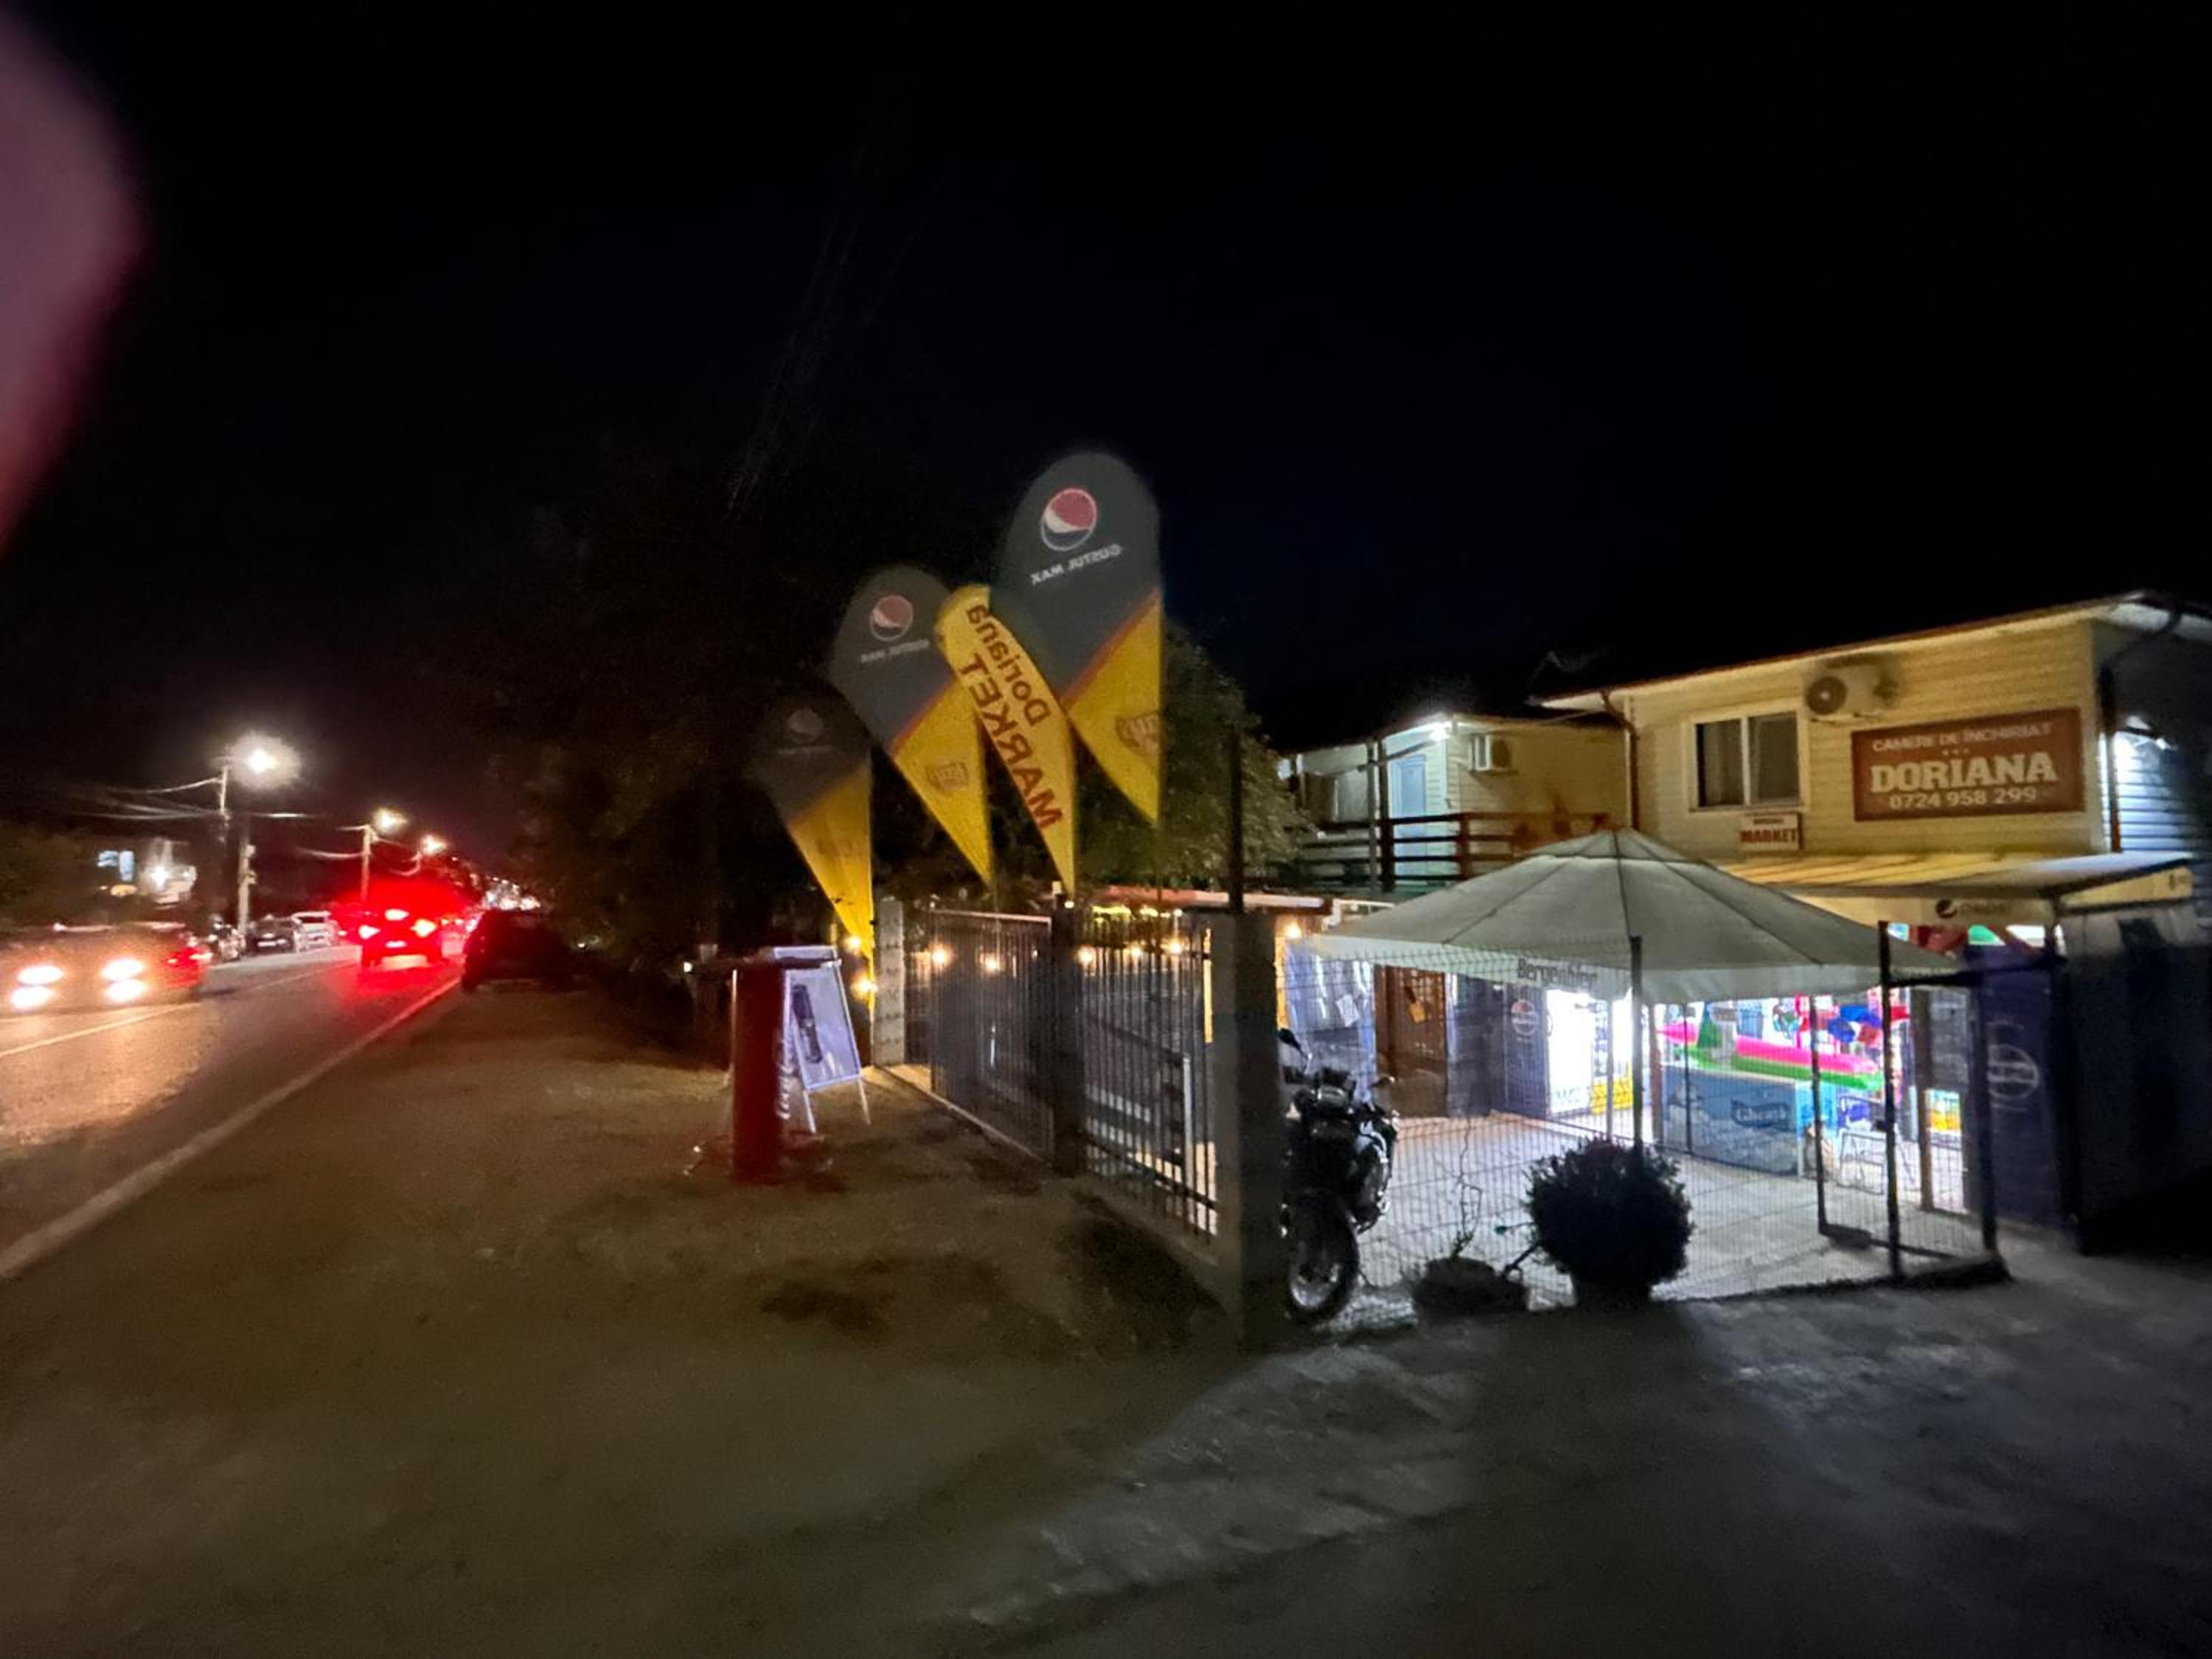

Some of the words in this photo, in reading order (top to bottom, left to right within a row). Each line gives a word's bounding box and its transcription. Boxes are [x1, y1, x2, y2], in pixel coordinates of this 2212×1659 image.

[1939, 732, 1959, 745] DE
[1870, 751, 2059, 793] DORIANA
[1889, 792, 1941, 810] 0724
[1947, 790, 1987, 807] 958
[1993, 787, 2037, 805] 299
